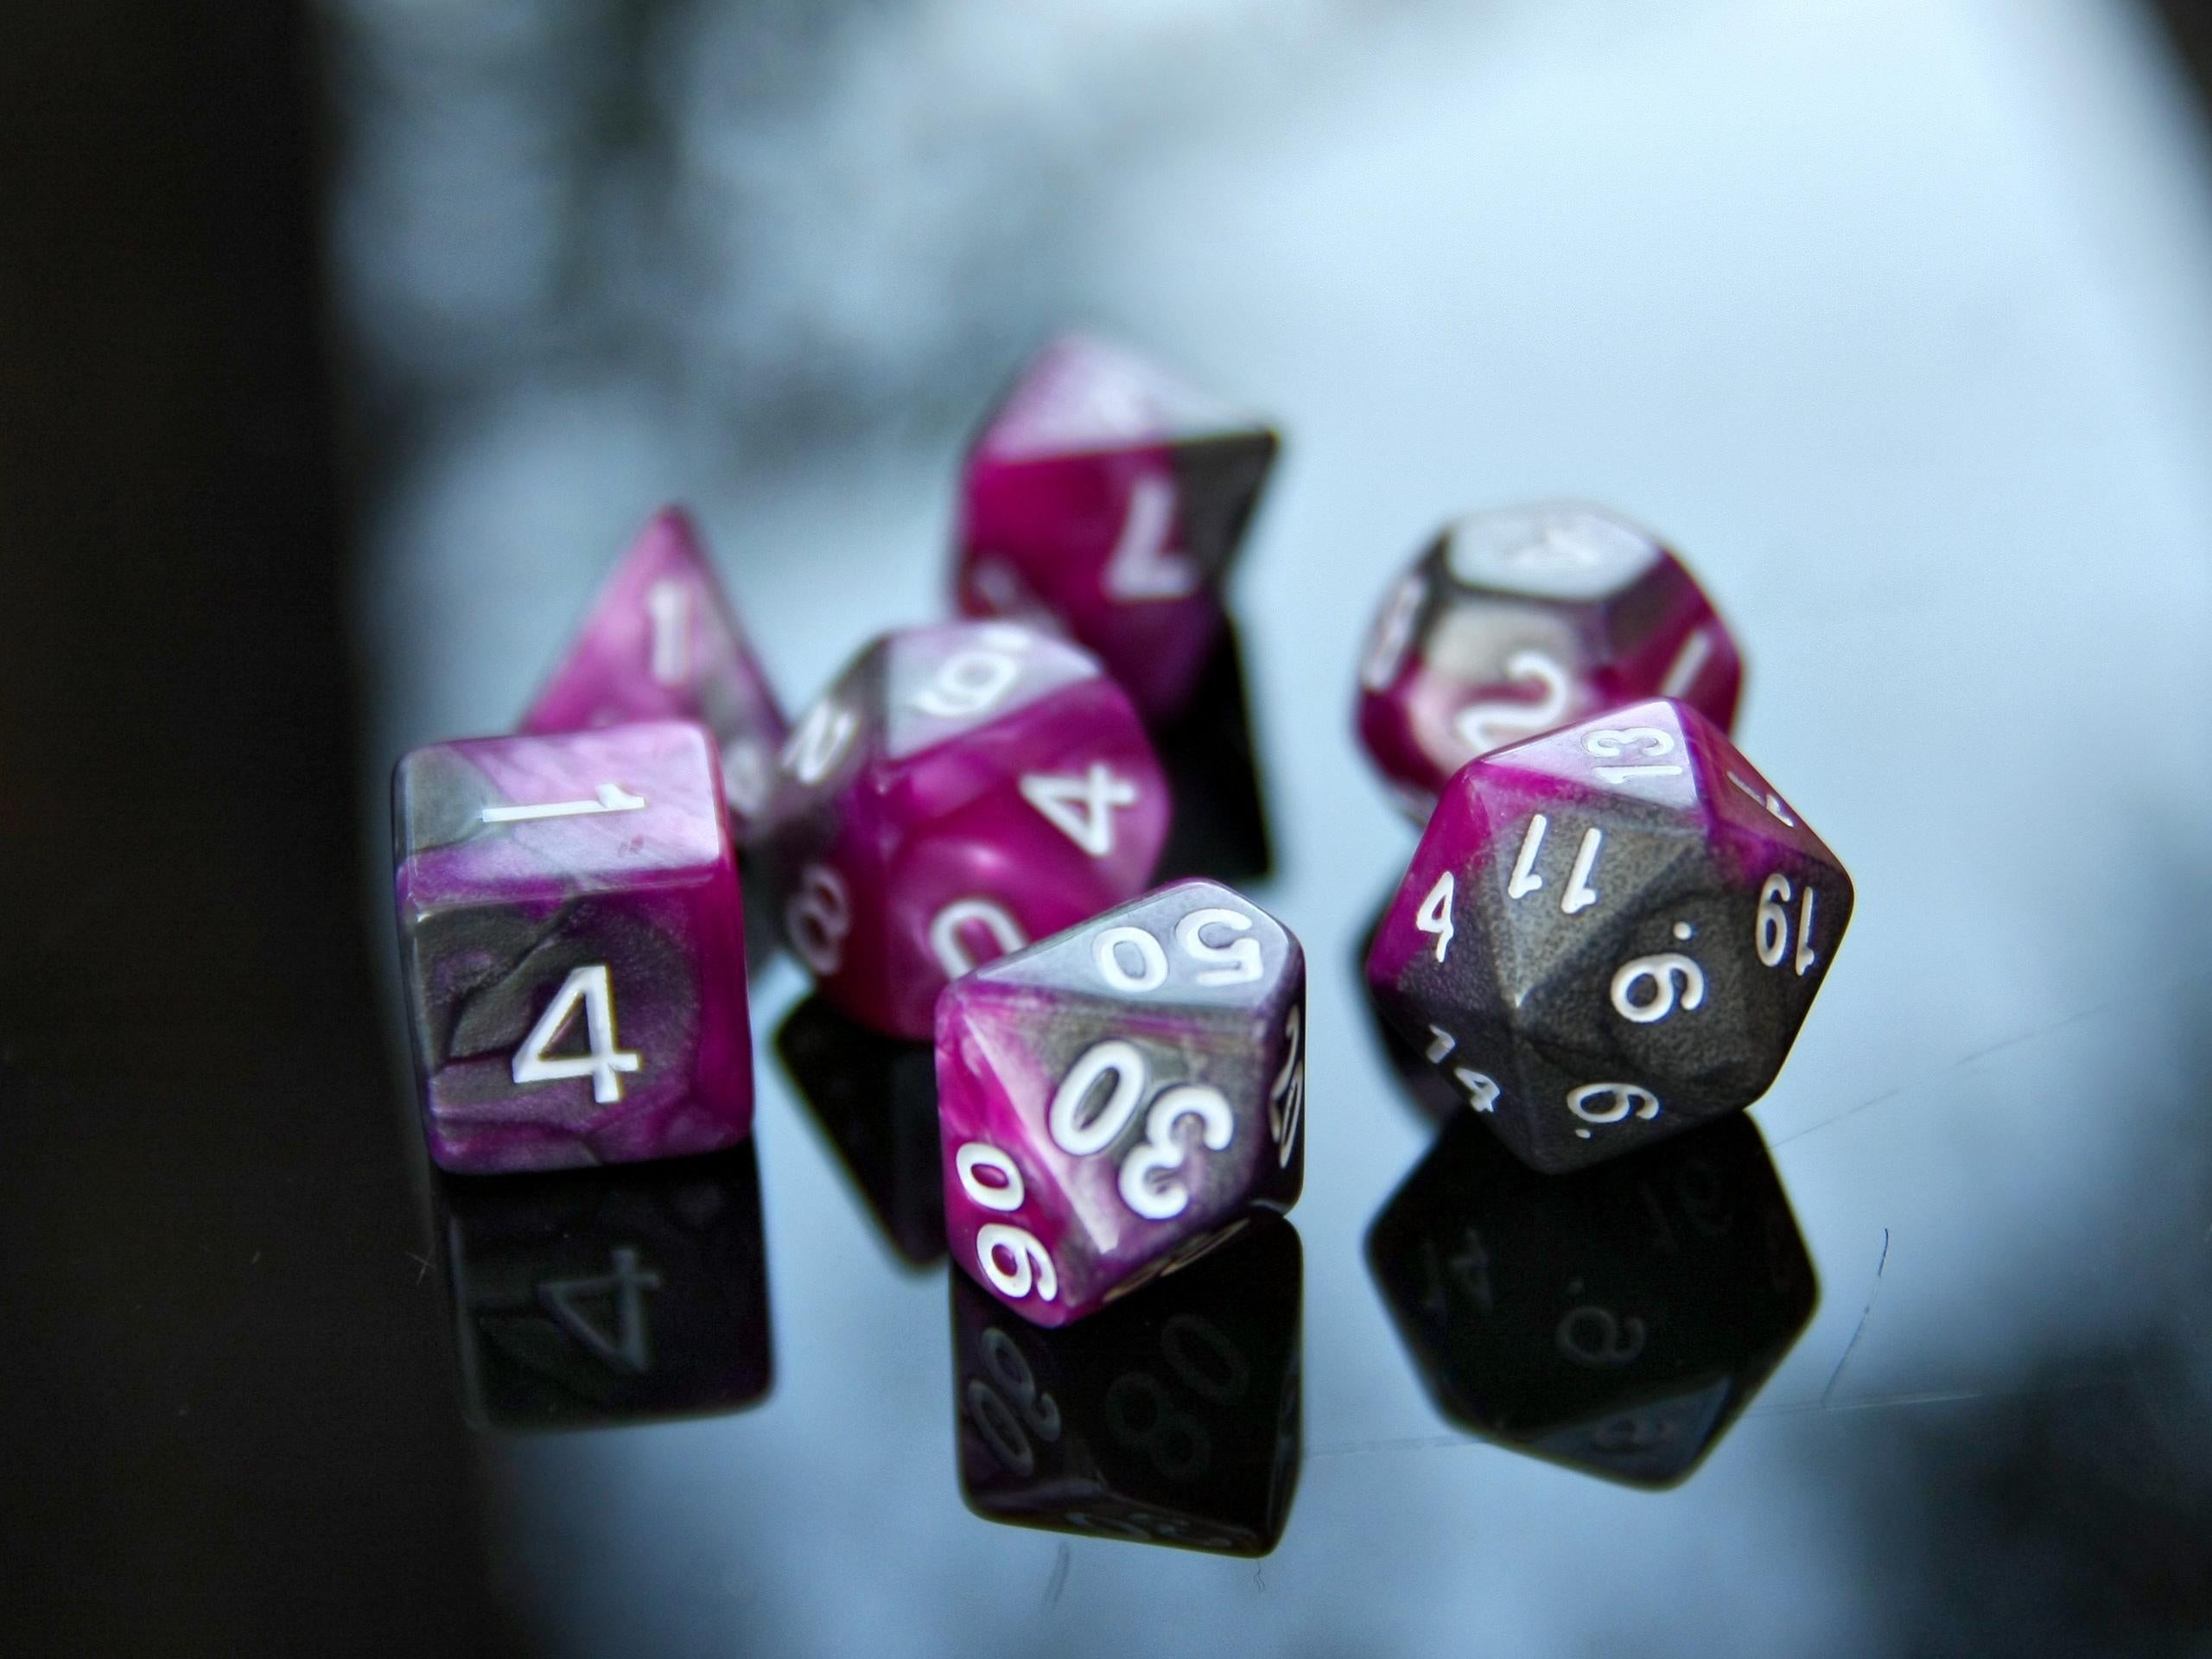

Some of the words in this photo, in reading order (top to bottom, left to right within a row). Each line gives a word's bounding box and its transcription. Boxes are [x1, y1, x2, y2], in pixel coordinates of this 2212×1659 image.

[481, 783, 645, 823] 1
[1580, 727, 1683, 785] 13
[1018, 762, 1139, 859] 4
[1507, 814, 1603, 914] 11
[1092, 908, 1263, 993] 50
[1416, 872, 1455, 963] 4
[1756, 873, 1815, 976] 19
[512, 964, 641, 1105] 4
[1049, 1039, 1235, 1221] 30
